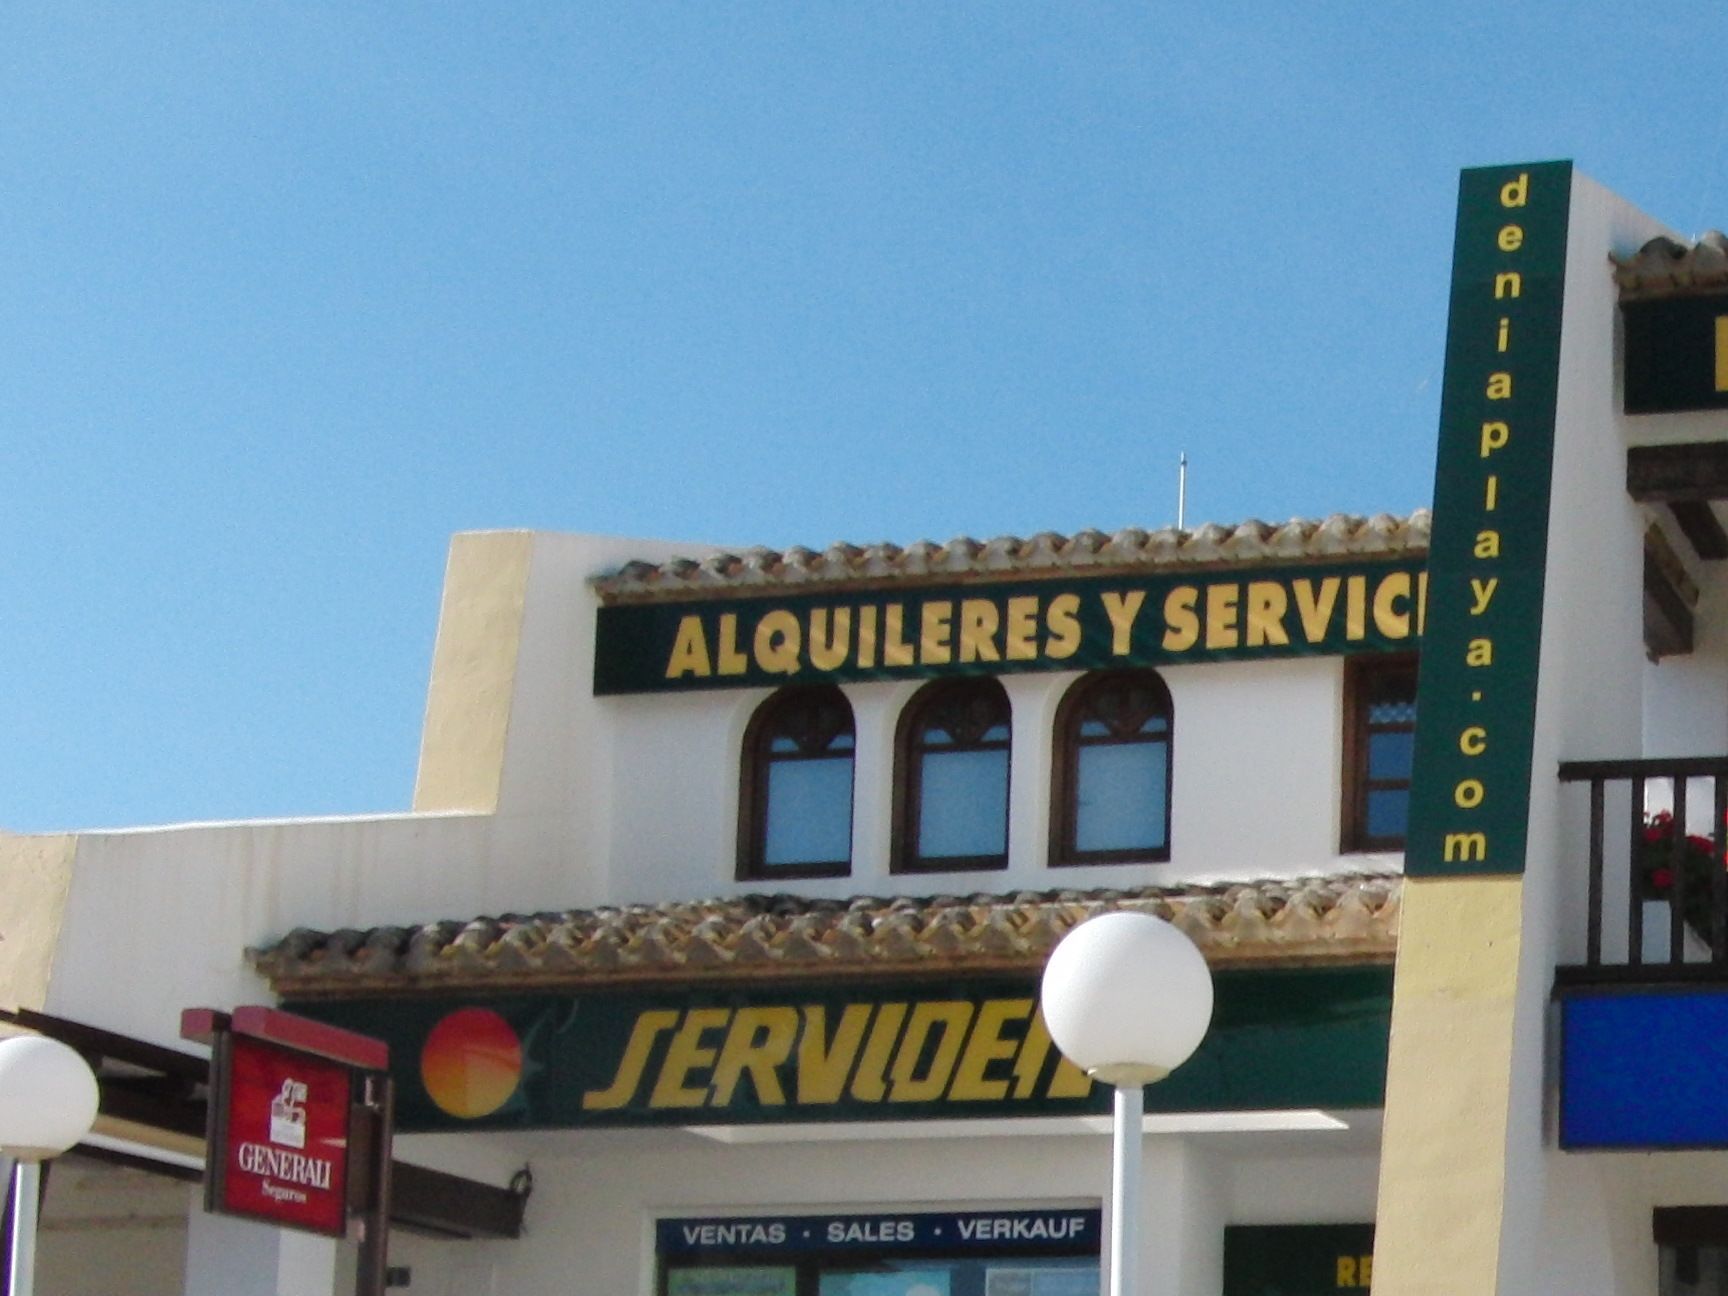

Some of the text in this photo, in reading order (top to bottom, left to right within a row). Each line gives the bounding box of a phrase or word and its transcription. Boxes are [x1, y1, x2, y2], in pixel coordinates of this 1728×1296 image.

[665, 593, 1081, 680] ALQUILERES
[1106, 588, 1149, 656] Y
[239, 1141, 331, 1190] GENERALI
[682, 1218, 1086, 1245] VENTAS SALES VERKAUF
